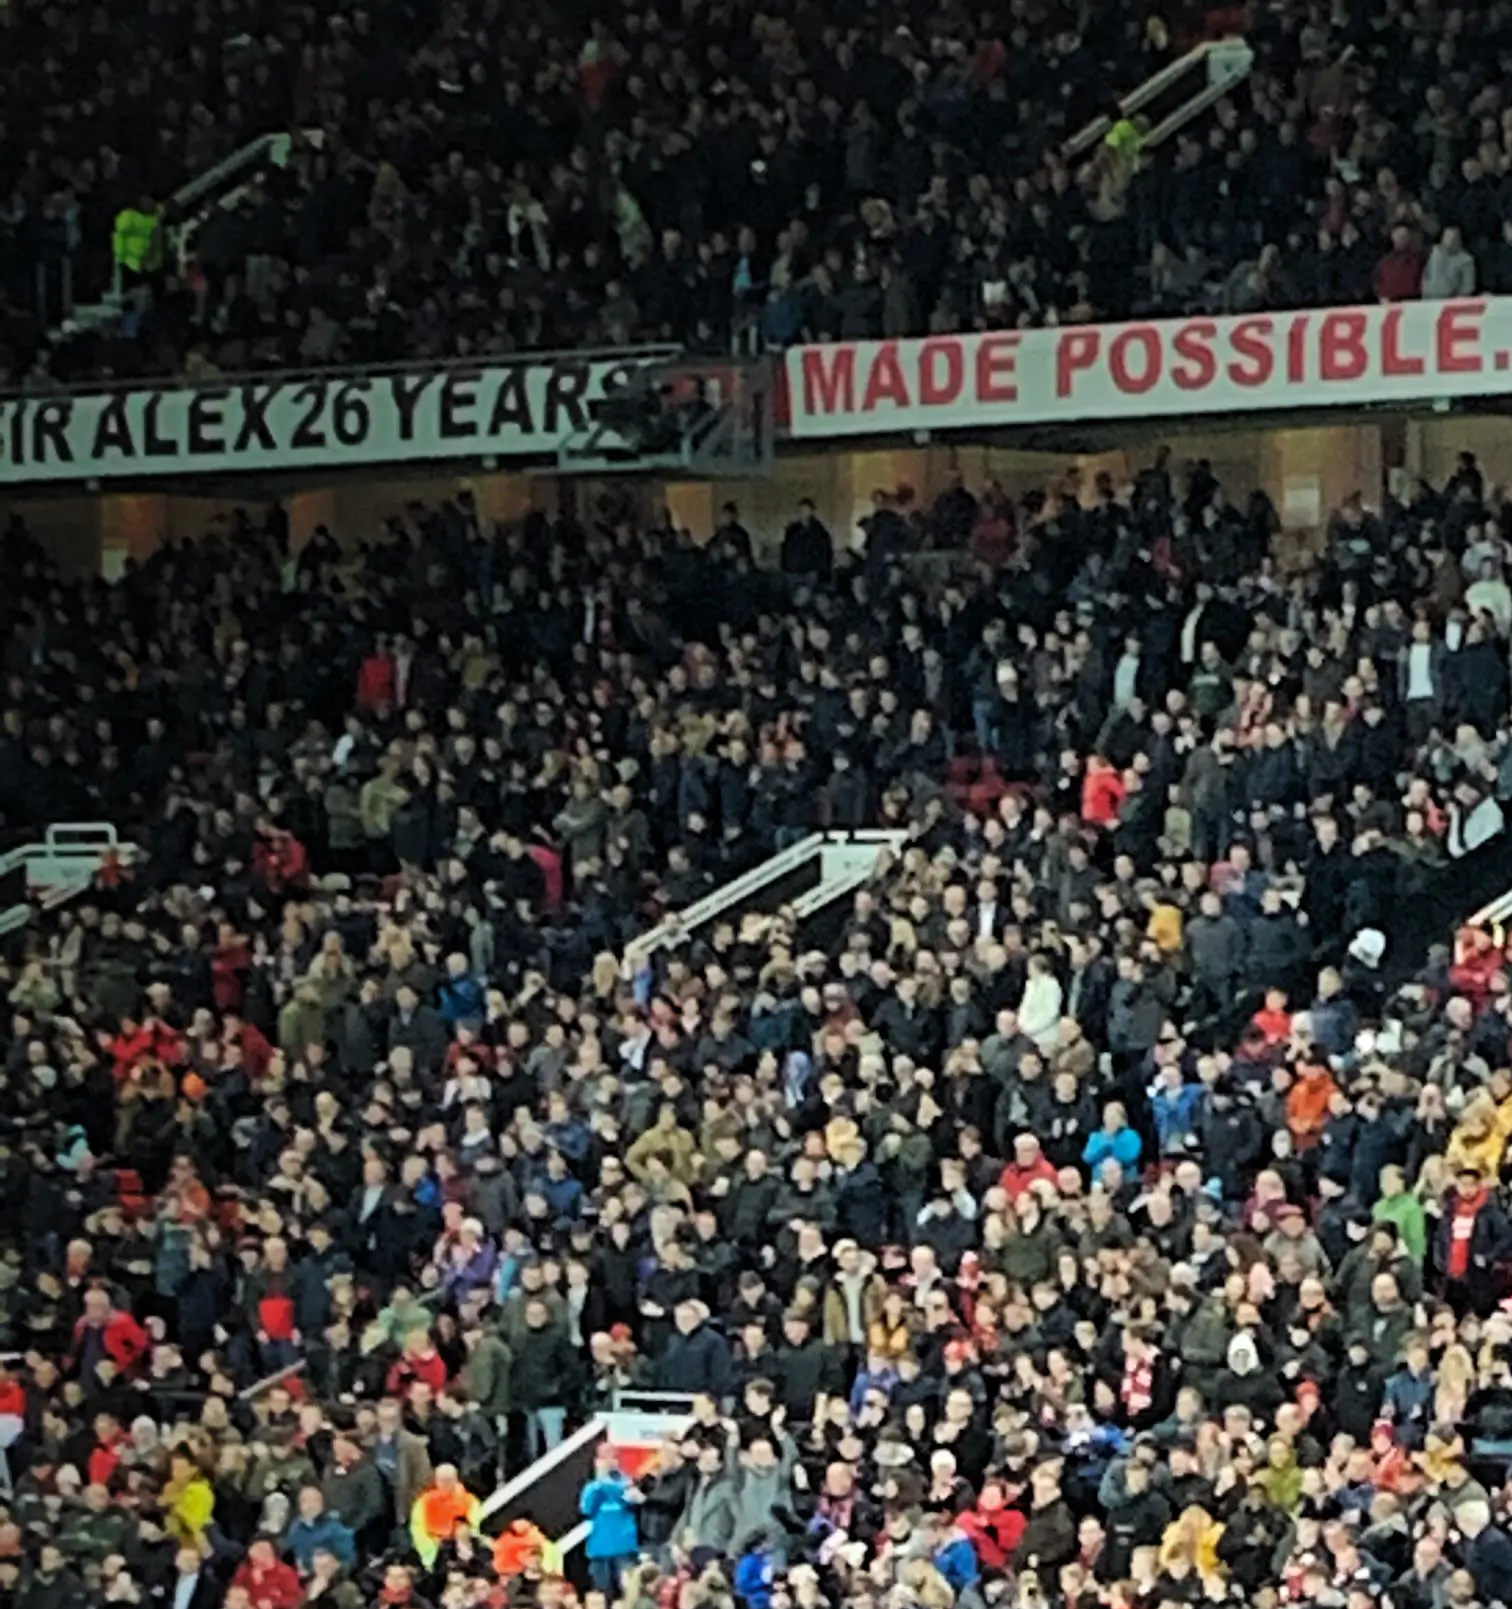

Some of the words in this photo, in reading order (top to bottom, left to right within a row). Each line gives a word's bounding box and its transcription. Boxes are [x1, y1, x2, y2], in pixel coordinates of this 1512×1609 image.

[803, 331, 1022, 416] MADE
[0, 396, 75, 464] IR
[91, 378, 283, 459] ALEX
[291, 375, 370, 449] 26
